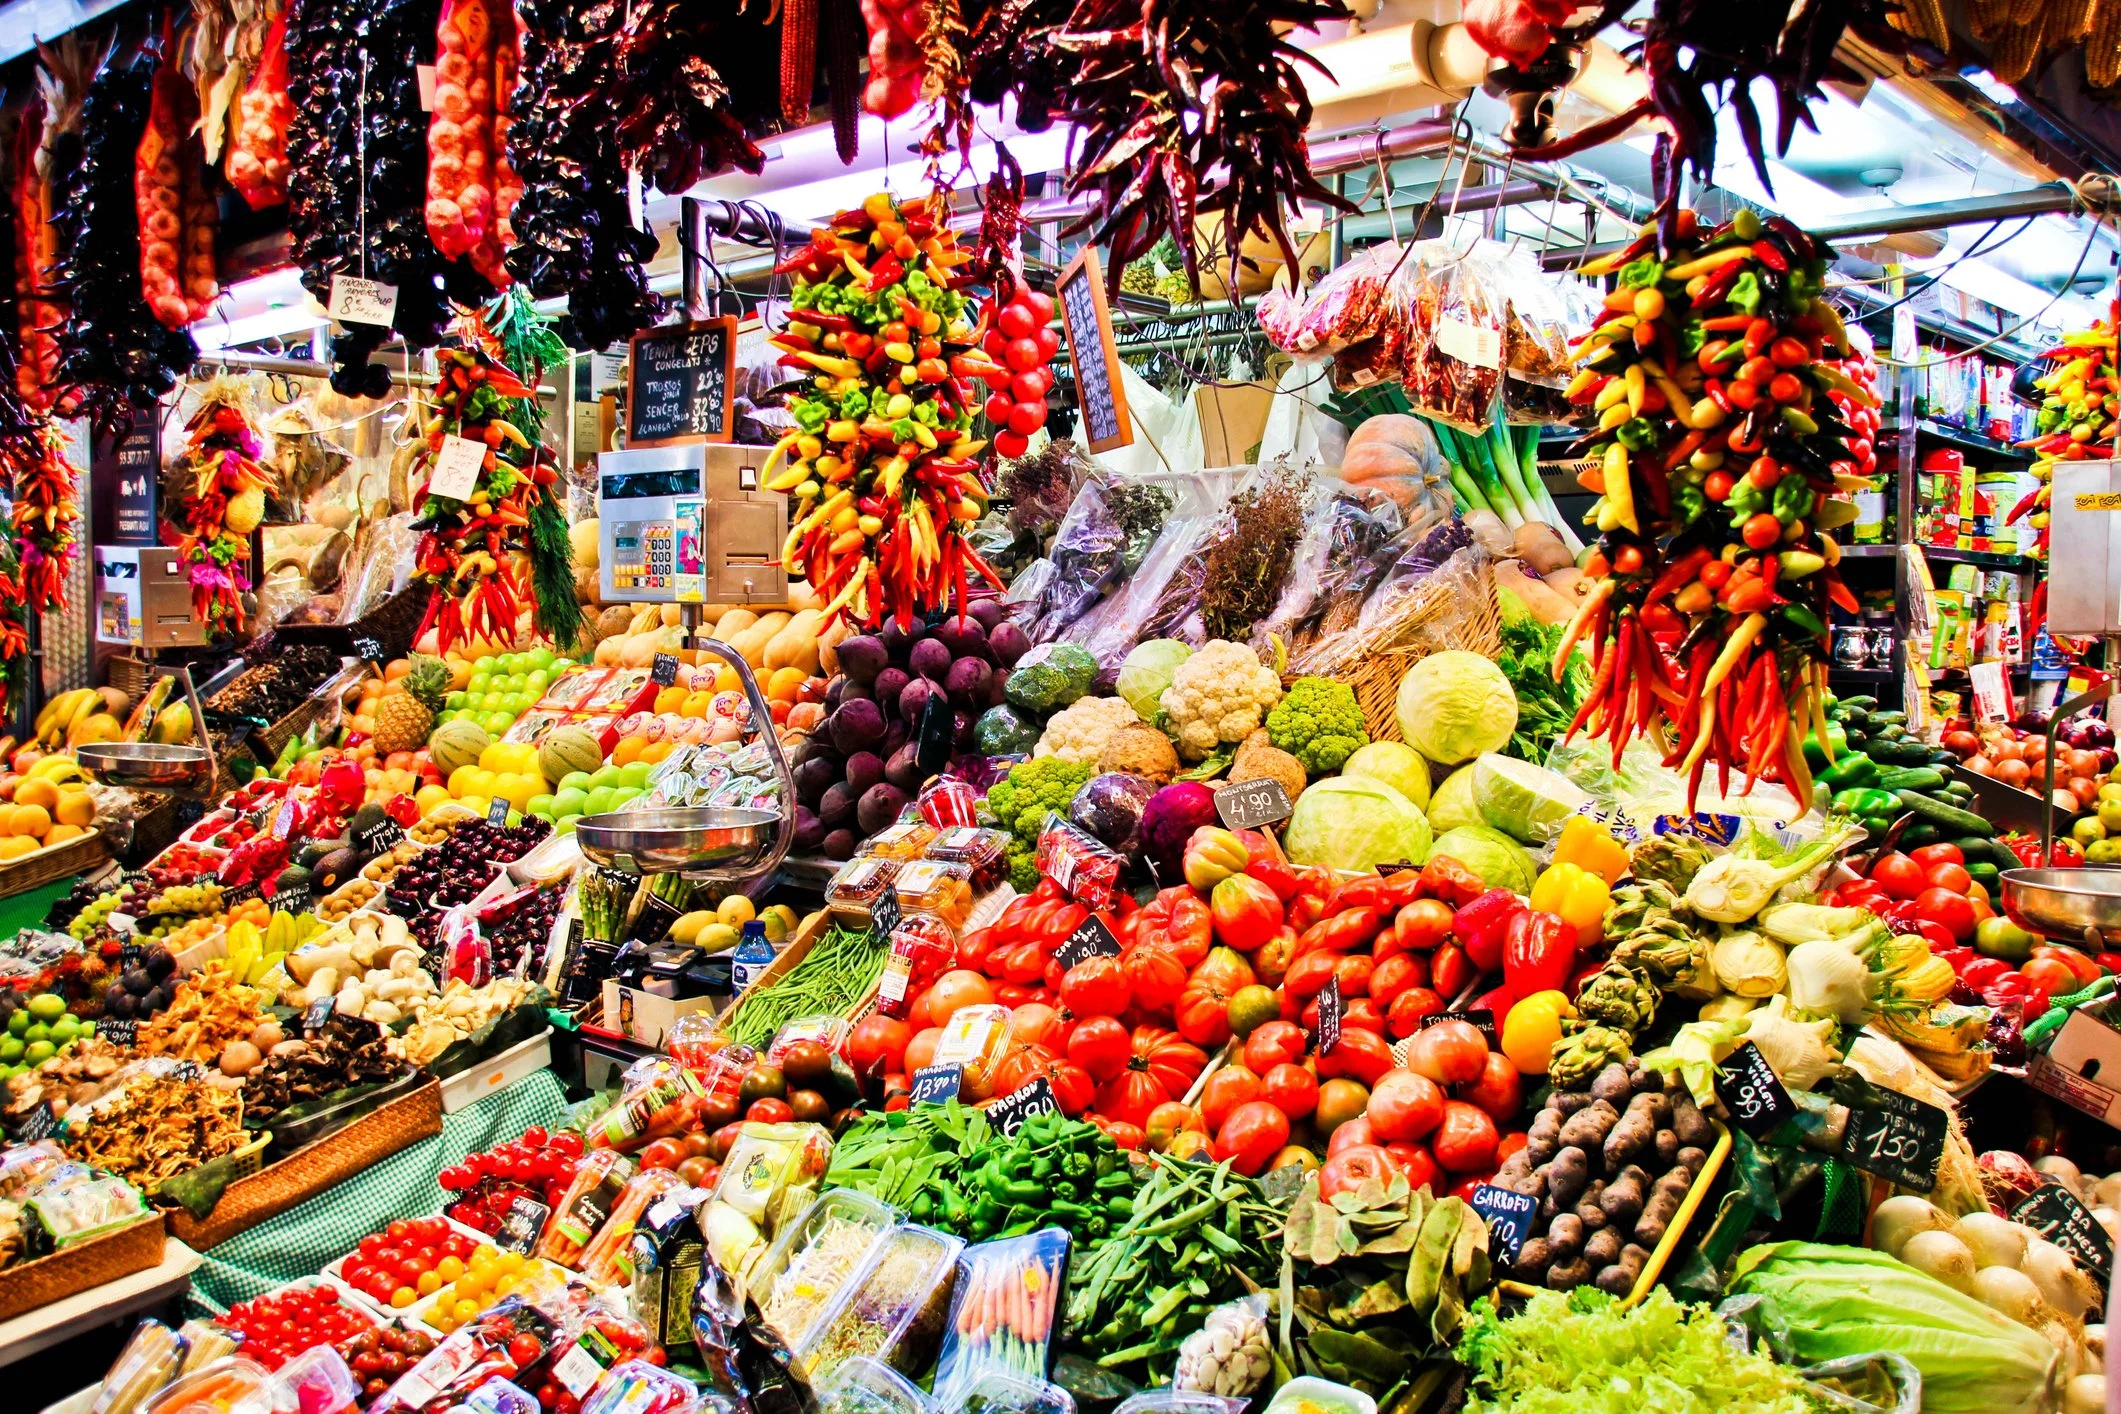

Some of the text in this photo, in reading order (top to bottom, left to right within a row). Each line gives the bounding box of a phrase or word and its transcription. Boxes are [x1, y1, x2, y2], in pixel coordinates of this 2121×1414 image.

[643, 334, 719, 360] TENIM CEPS
[655, 357, 701, 371] CONGELATS
[645, 402, 680, 418] SENCER
[1218, 779, 1274, 797] MONTSERRAT
[1230, 792, 1272, 821] 4'90
[96, 1020, 137, 1031] SHITAKE
[909, 1076, 950, 1103] 13'90
[2055, 1188, 2091, 1231] CEBA
